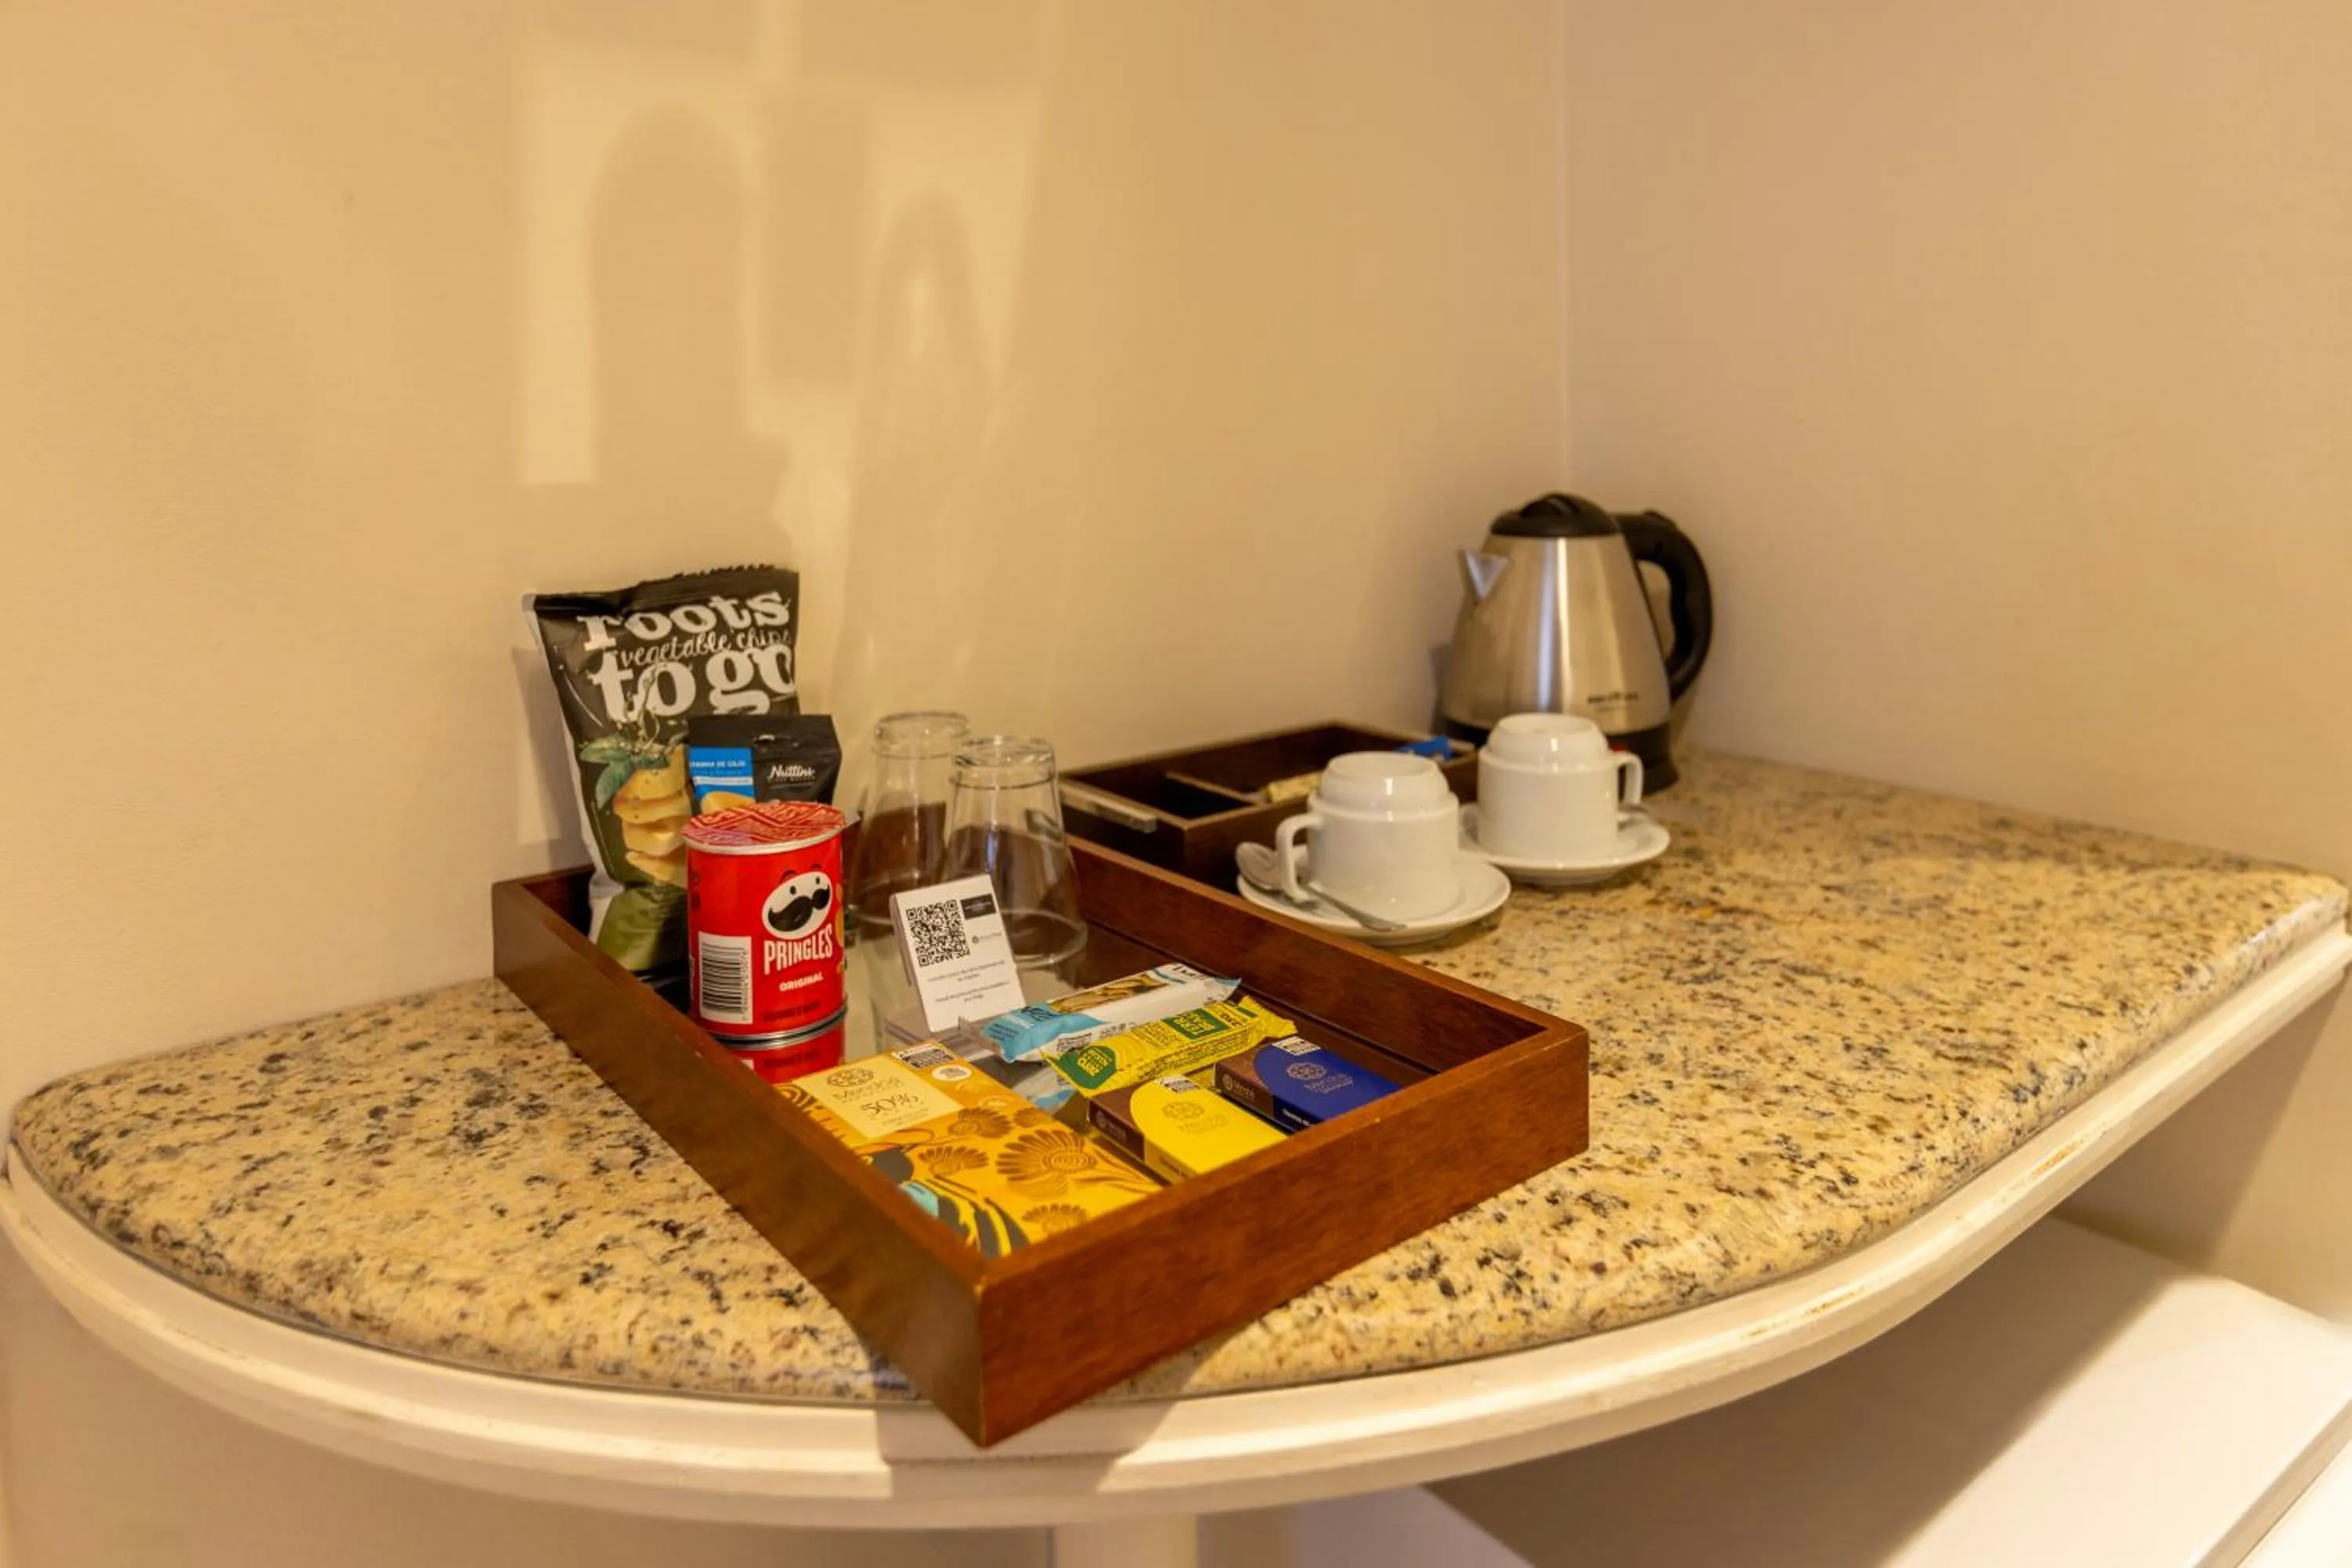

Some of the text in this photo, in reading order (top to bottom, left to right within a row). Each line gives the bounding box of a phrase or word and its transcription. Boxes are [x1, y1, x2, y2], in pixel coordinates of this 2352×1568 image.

[576, 591, 791, 651] roots
[621, 630, 731, 666] vegetable
[587, 643, 797, 723] to go
[764, 923, 833, 975] PRINGLES
[779, 972, 825, 992] ORIGINAL
